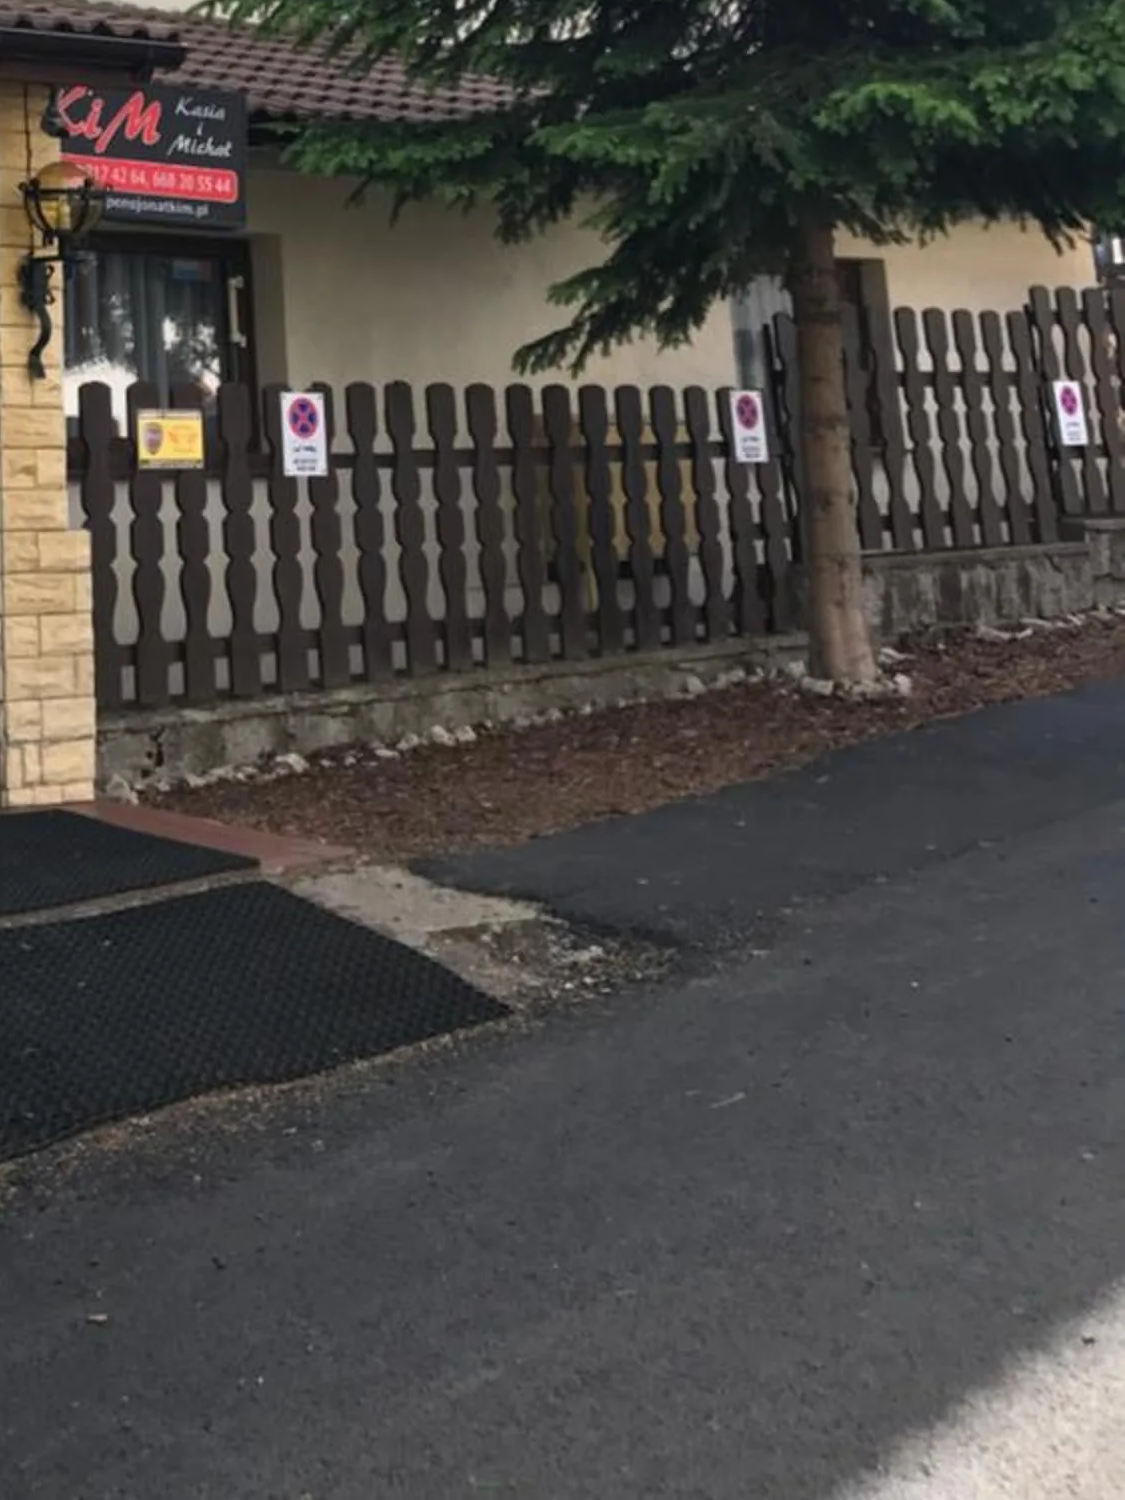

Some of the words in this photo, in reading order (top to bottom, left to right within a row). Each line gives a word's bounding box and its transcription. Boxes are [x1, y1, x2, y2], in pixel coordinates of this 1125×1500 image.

[175, 96, 226, 120] Kasia
[196, 121, 203, 136] i
[197, 175, 213, 192] 55
[214, 177, 232, 193] 44
